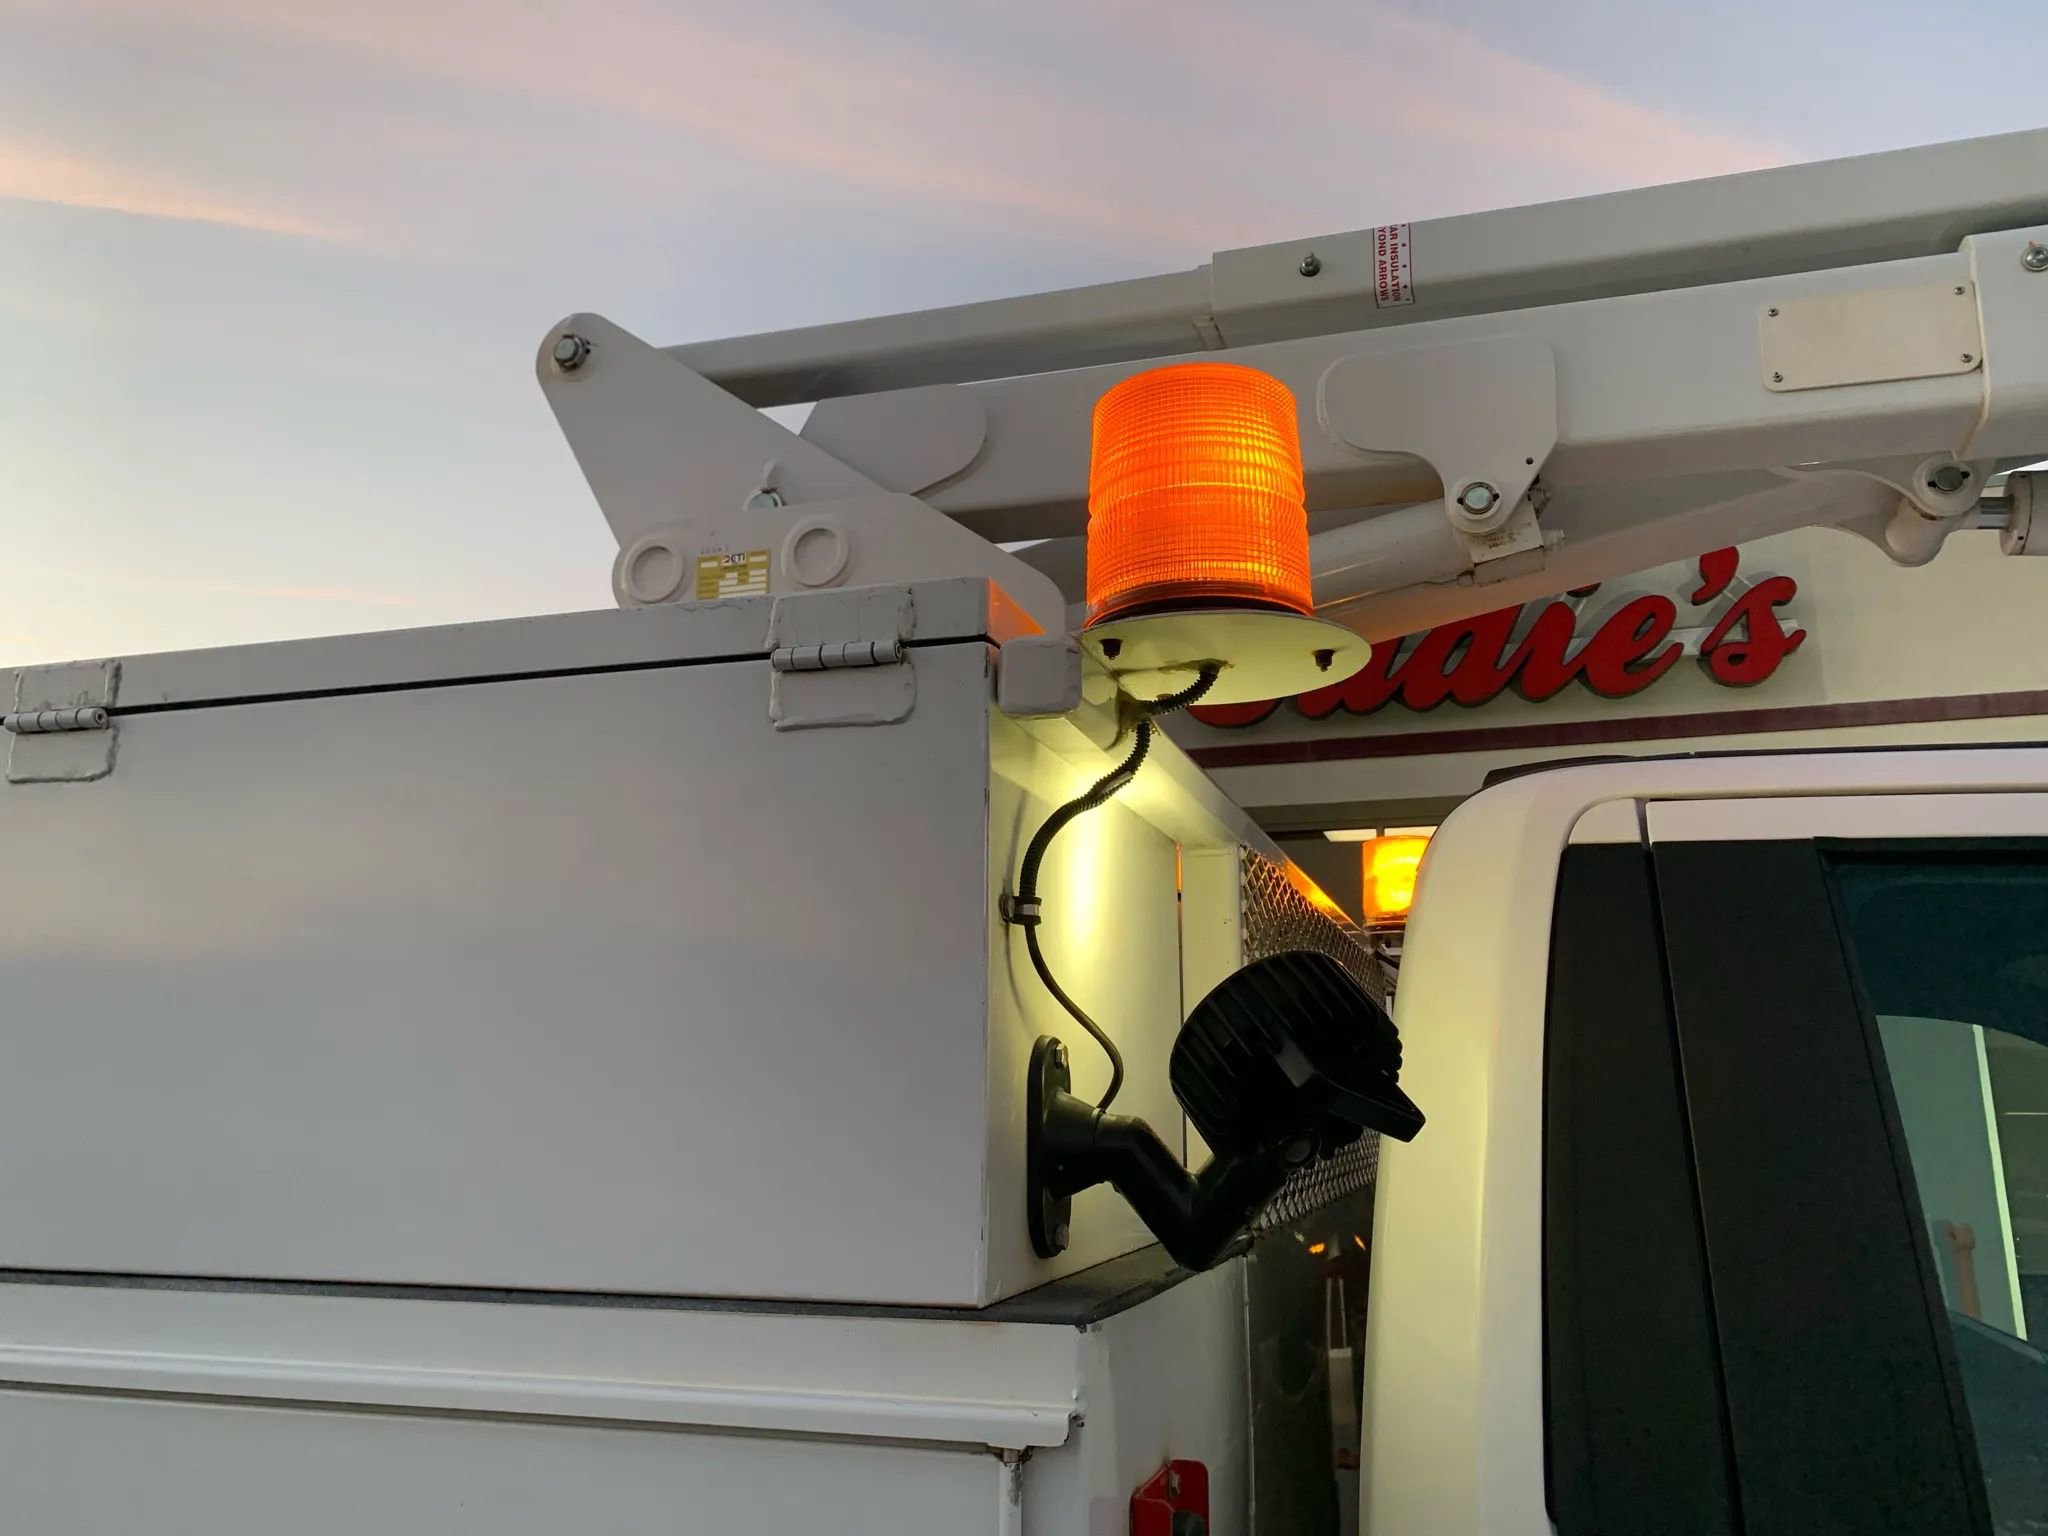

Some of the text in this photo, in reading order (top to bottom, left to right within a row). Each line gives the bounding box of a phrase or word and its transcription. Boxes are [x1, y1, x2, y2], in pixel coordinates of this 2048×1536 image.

[1379, 260, 1389, 301] ARROWS
[1390, 225, 1402, 302] AR INSULATION
